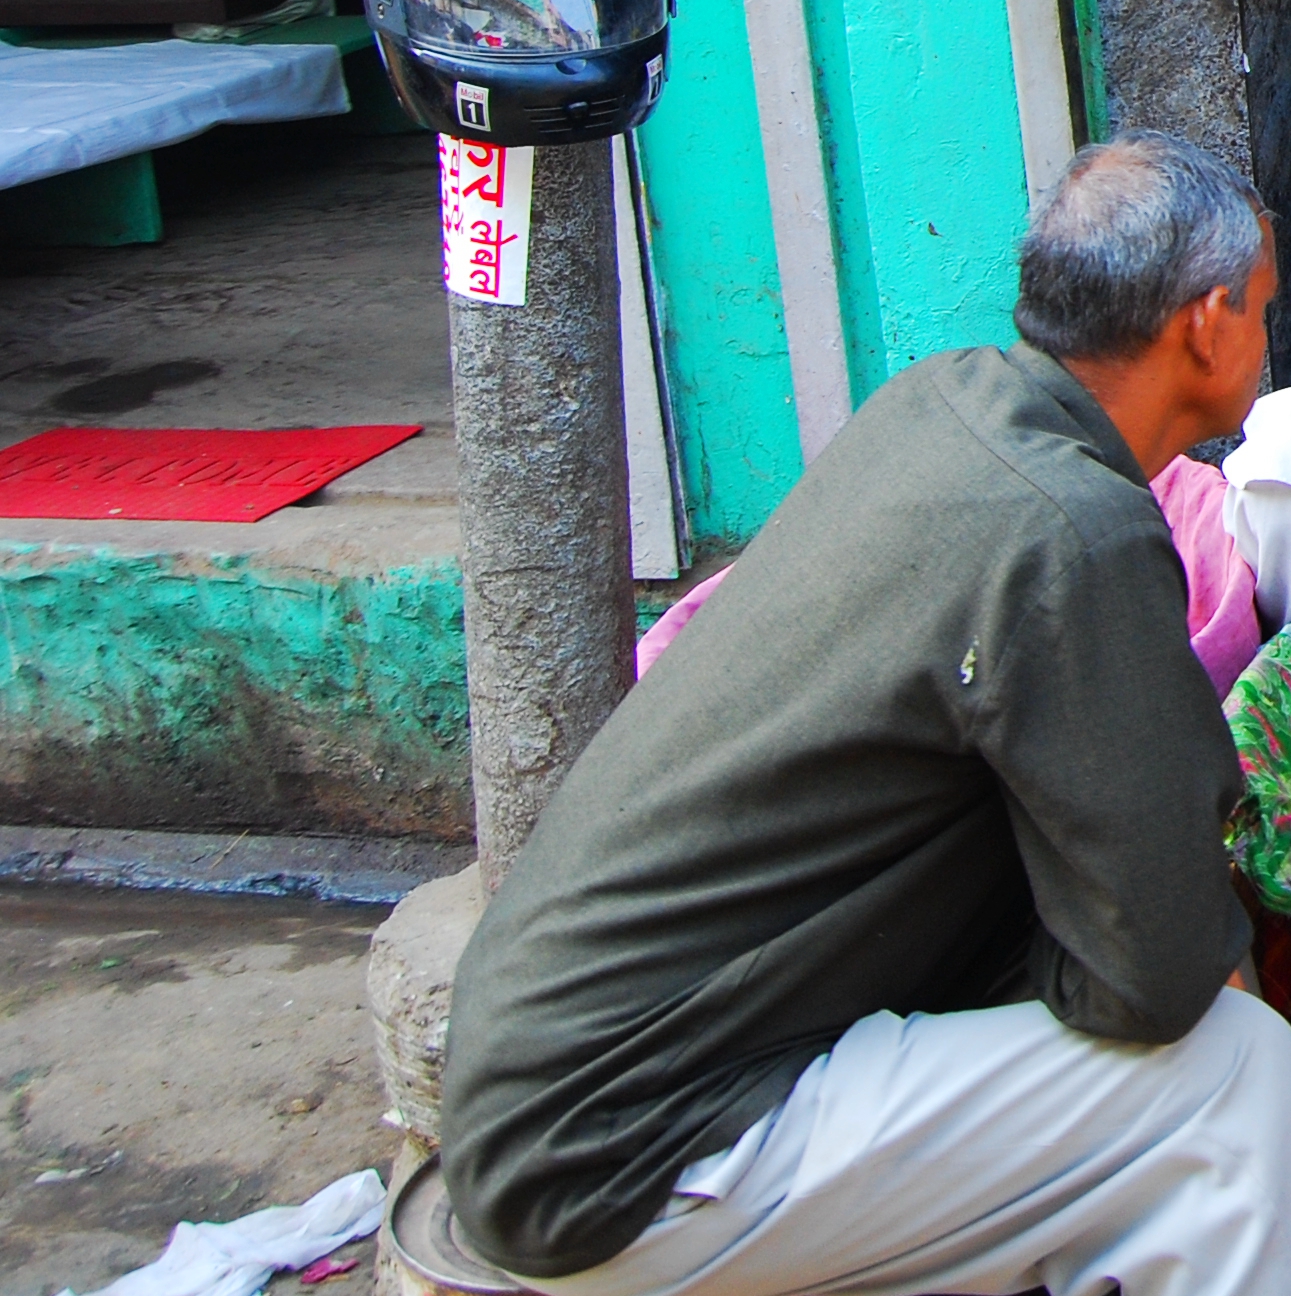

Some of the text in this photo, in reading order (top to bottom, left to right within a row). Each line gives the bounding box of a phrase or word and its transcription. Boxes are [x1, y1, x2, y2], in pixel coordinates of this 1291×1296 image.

[460, 87, 485, 102] Mobil
[466, 103, 478, 124] 1
[469, 219, 519, 299] लेबल
